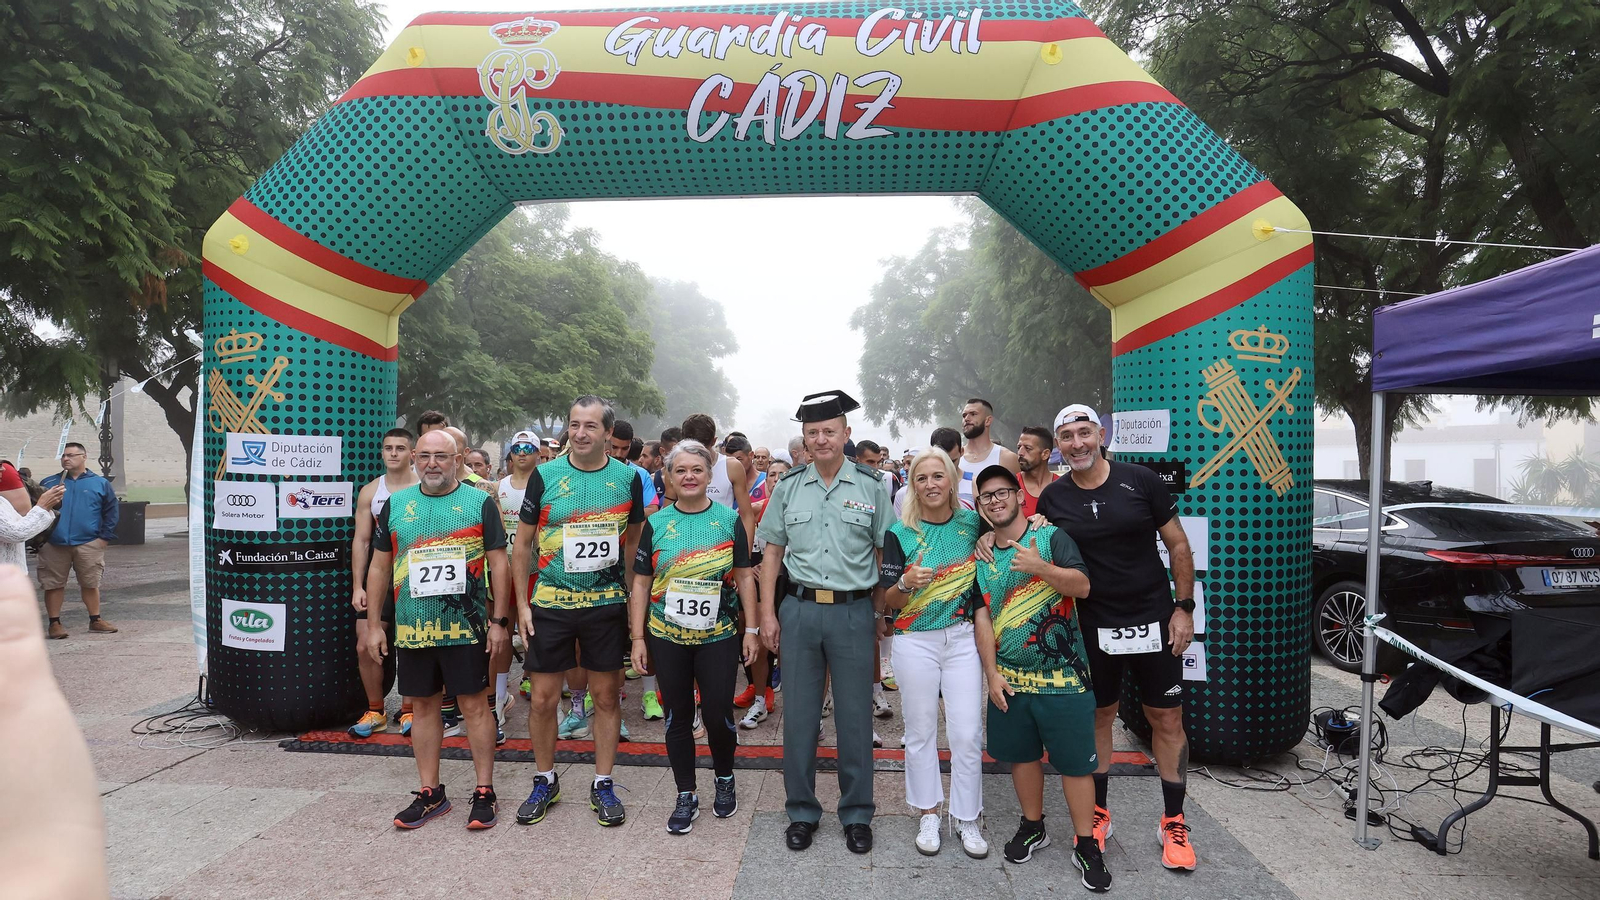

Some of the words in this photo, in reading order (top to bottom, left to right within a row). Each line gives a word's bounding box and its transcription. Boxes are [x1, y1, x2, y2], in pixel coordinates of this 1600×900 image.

[604, 9, 828, 67] Guardia
[855, 7, 984, 58] Civil
[686, 62, 903, 146] CÁDIZ
[1120, 418, 1162, 431] Diputación
[1120, 434, 1129, 444] de
[1130, 433, 1153, 445] Cádiz
[271, 441, 333, 455] Diputación
[271, 457, 286, 468] de
[290, 457, 323, 468] Cádiz
[312, 495, 344, 506] Tere
[221, 511, 241, 519] Solera
[242, 511, 265, 519] Motor
[575, 540, 610, 559] 229
[236, 551, 288, 563] Fundación
[419, 564, 456, 584] 273
[1551, 571, 1578, 584] 0787
[1580, 570, 1600, 583] NCS
[676, 598, 711, 617] 136
[232, 611, 270, 629] vila
[1111, 624, 1150, 640] 359
[246, 636, 275, 644] Congelados
